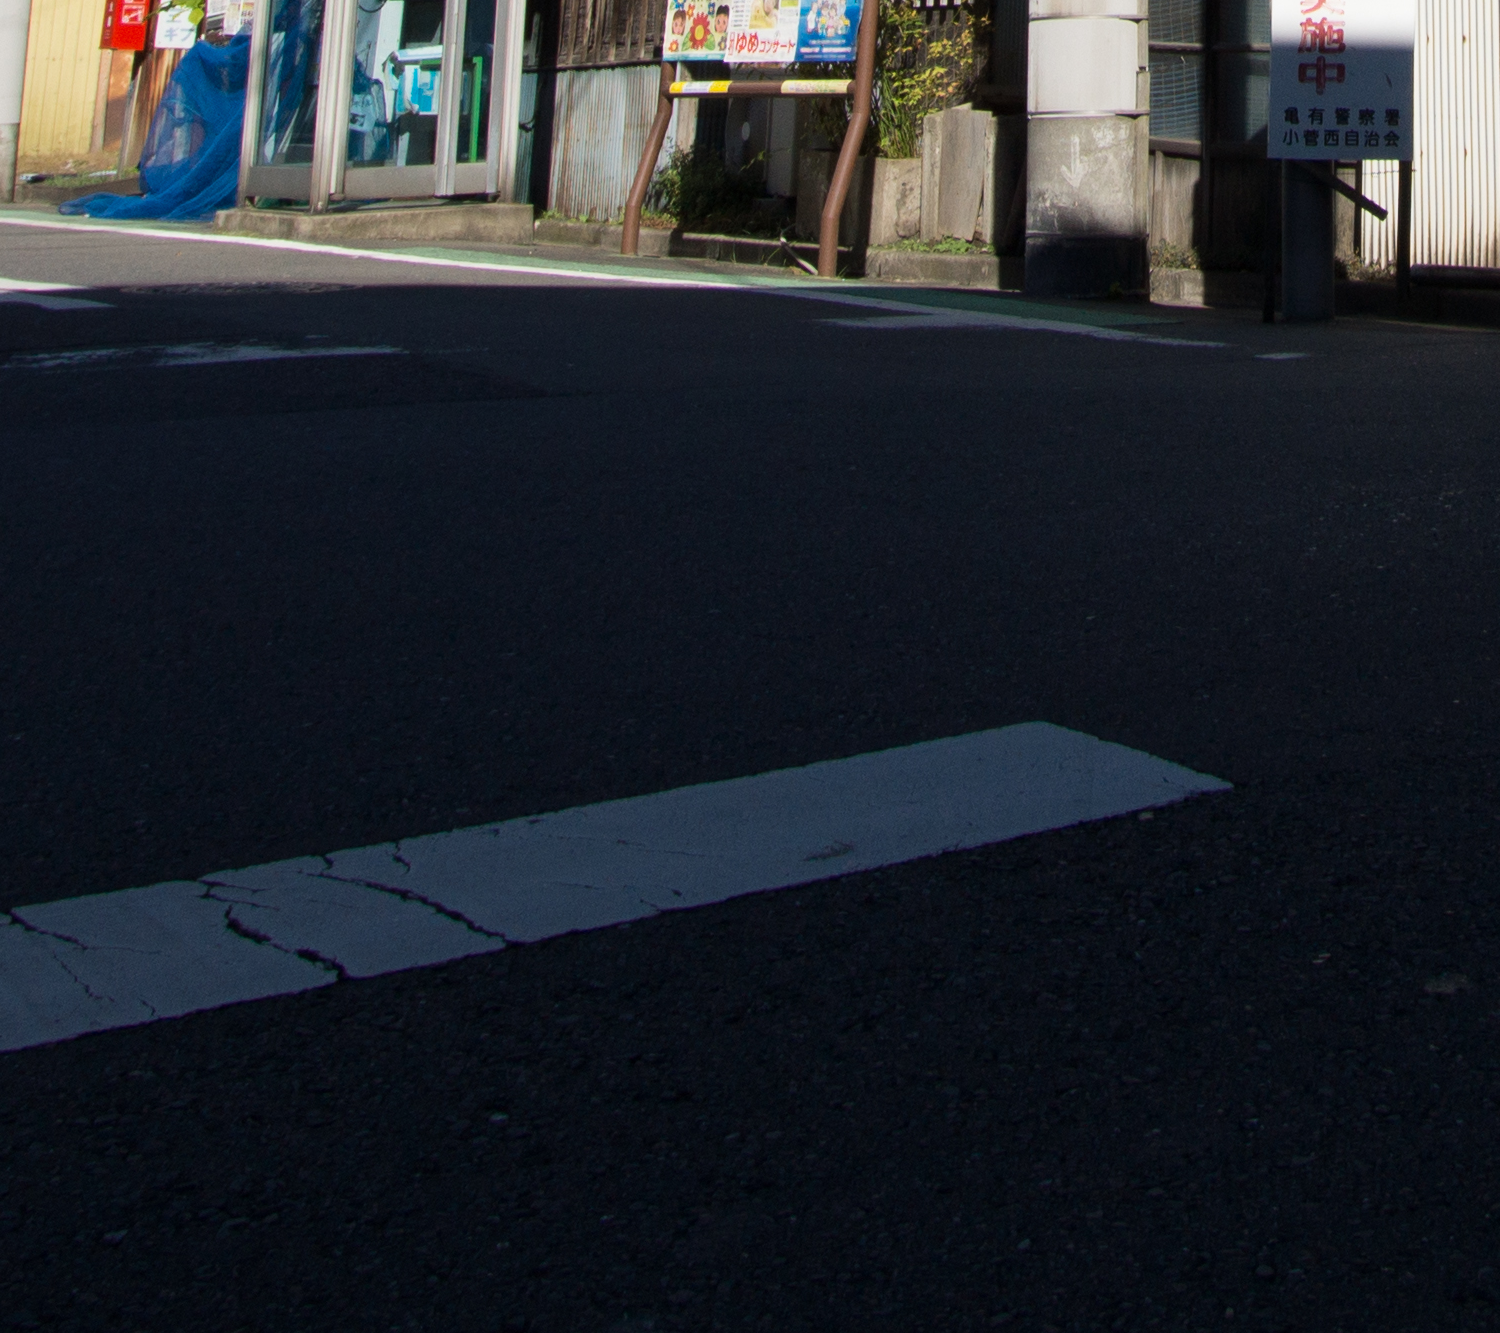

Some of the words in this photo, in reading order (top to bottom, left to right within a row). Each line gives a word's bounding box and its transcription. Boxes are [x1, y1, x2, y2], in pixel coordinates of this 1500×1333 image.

[735, 31, 796, 54] ゆめコンサート
[1283, 106, 1401, 127] 亀有警察署
[1282, 128, 1400, 148] 小菅西自治会
